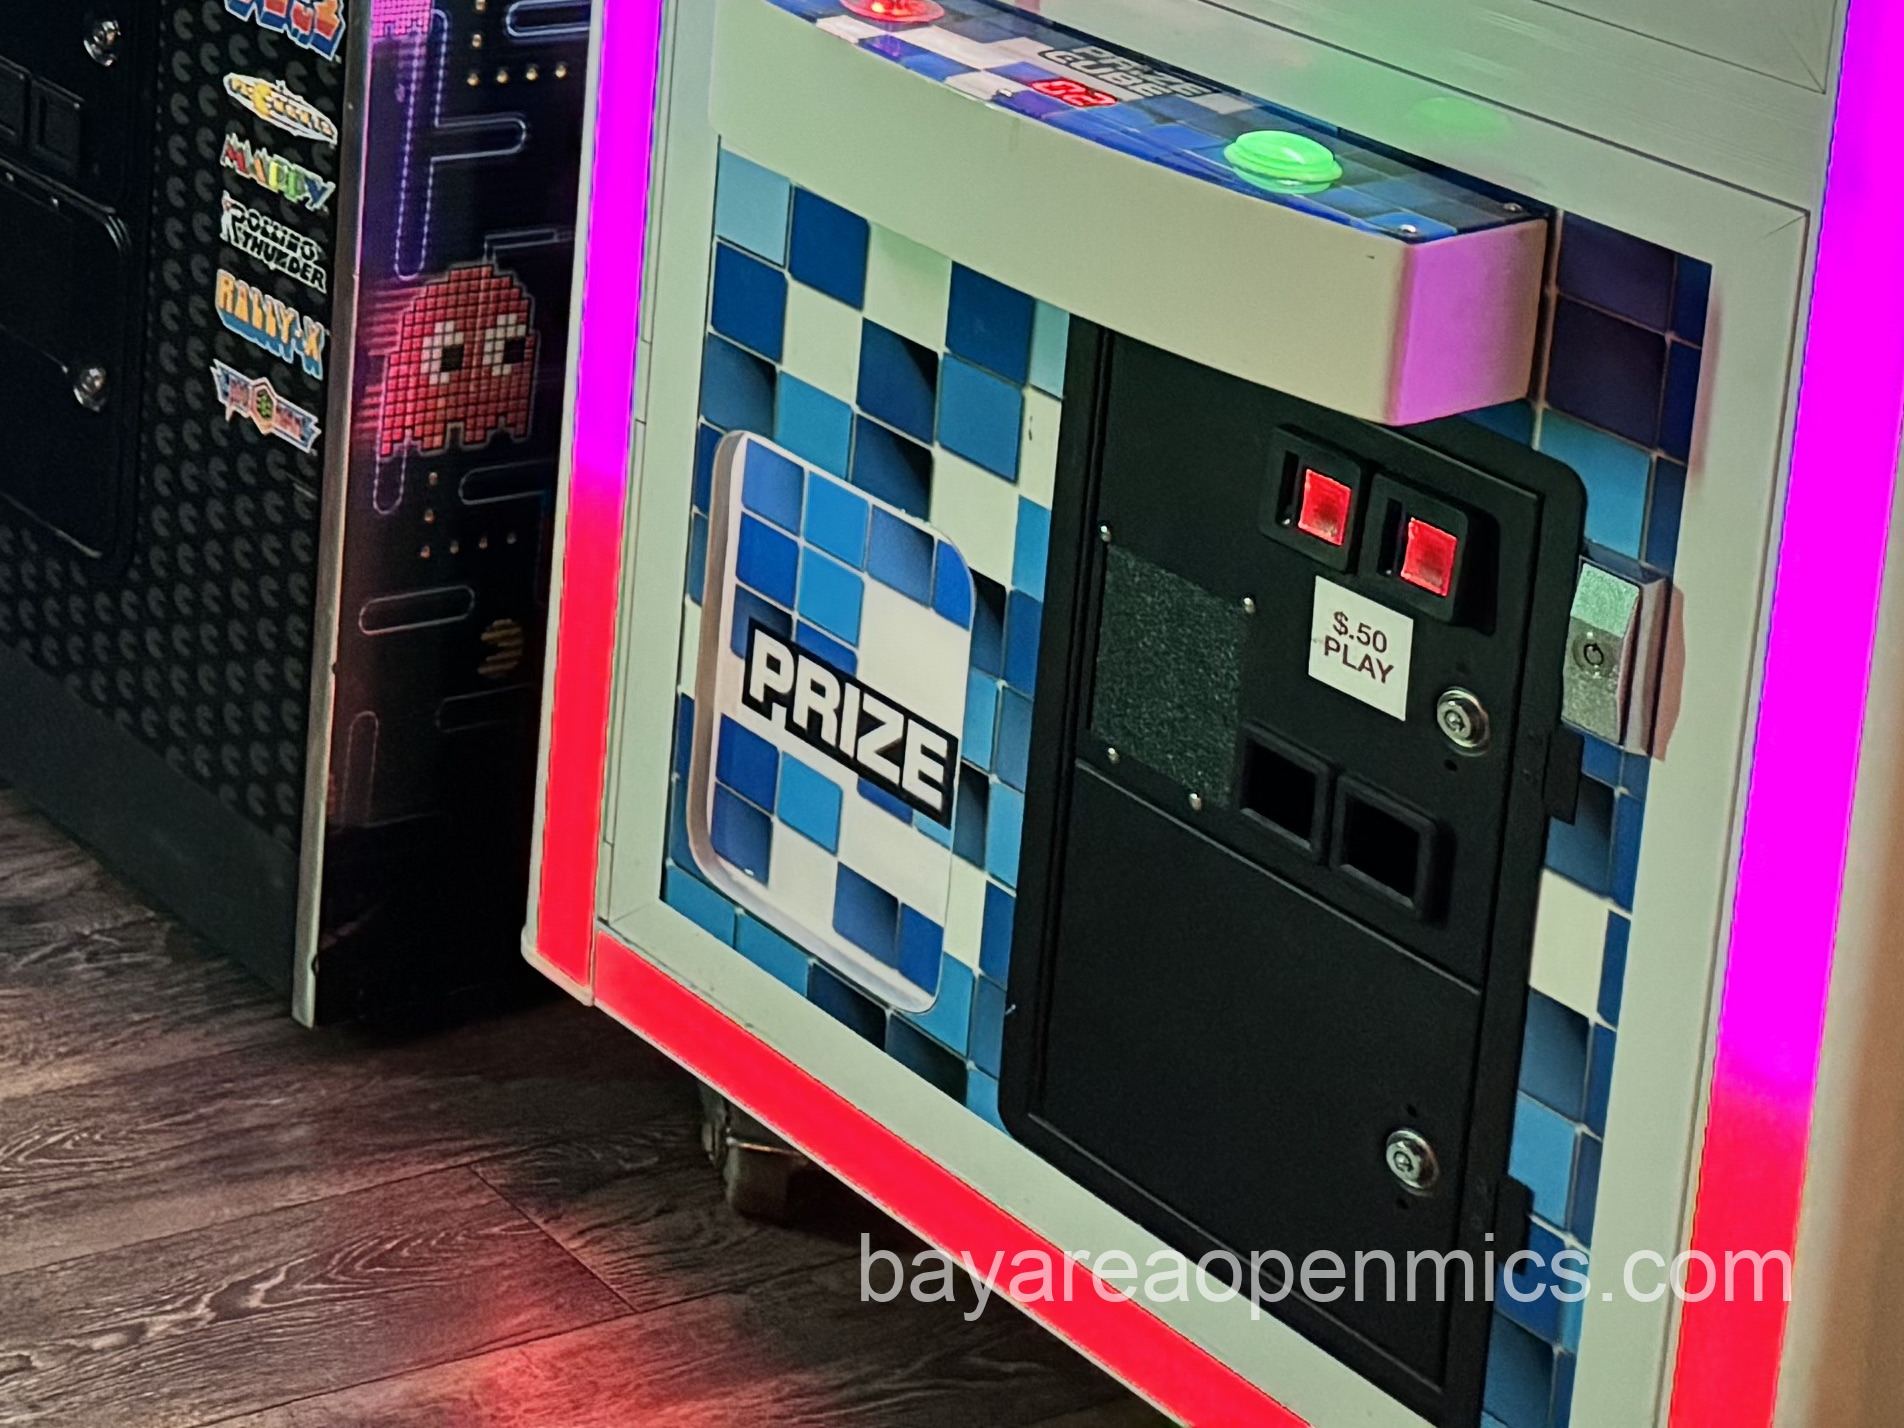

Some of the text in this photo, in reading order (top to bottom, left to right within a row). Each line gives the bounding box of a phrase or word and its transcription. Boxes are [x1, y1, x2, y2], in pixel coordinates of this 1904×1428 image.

[220, 133, 336, 210] MAPPY
[238, 226, 327, 293] THUNDER
[215, 268, 325, 381] RALLY-X
[1322, 632, 1397, 685] PLAY
[1331, 607, 1390, 655] $.50
[746, 632, 958, 812] PRIZE
